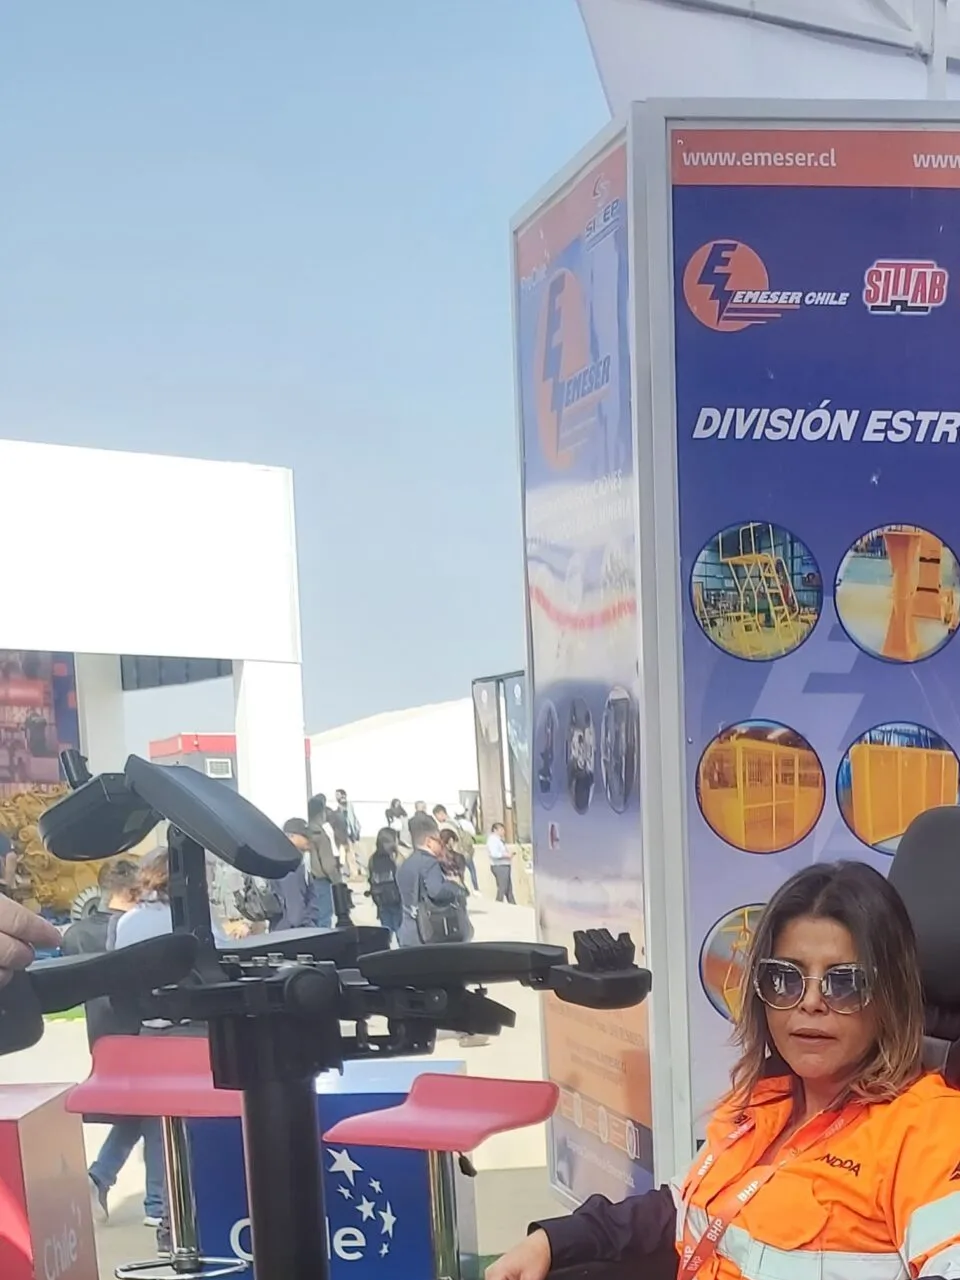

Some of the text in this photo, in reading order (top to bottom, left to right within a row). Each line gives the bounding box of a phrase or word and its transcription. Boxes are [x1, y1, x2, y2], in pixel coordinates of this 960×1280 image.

[682, 148, 837, 168] www.emeser.cl
[864, 261, 947, 305] SITTAB
[732, 290, 851, 306] EMESER CHILE
[565, 355, 611, 408] EMESER
[693, 399, 860, 442] DIVISIÓN
[697, 1153, 715, 1178] BHP
[736, 1179, 761, 1204] BHP
[229, 1216, 367, 1262] Cle
[706, 1217, 725, 1243] BHP
